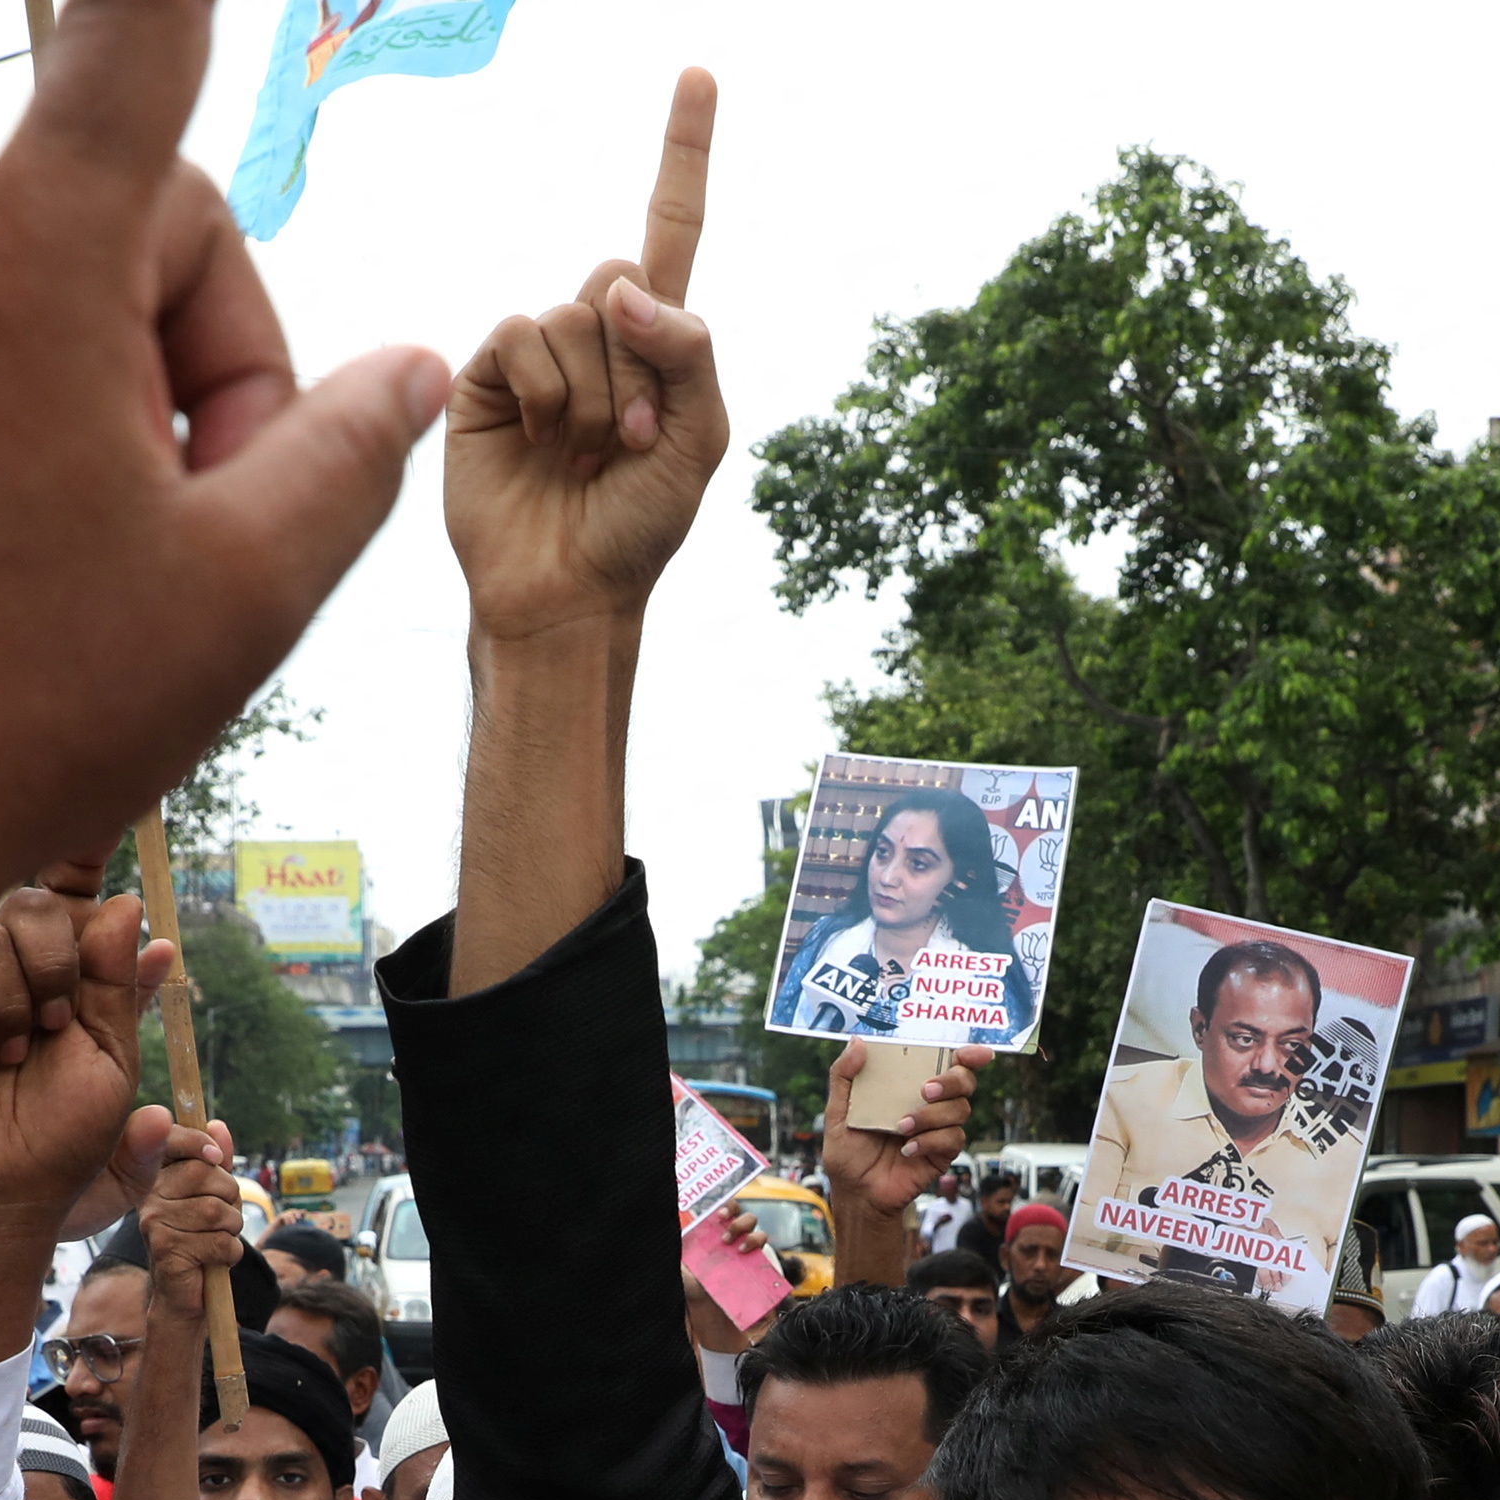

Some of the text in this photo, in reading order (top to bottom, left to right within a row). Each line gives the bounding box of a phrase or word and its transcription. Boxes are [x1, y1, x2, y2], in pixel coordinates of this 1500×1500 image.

[981, 794, 1002, 805] BJP
[916, 952, 1008, 973] ARREST
[915, 977, 1000, 999] NUPUR
[901, 1002, 1005, 1026] SHARMA
[678, 1157, 739, 1208] SHARMA
[1160, 1181, 1267, 1224] ARREST
[1100, 1202, 1307, 1272] NAVEEN JINDAL
